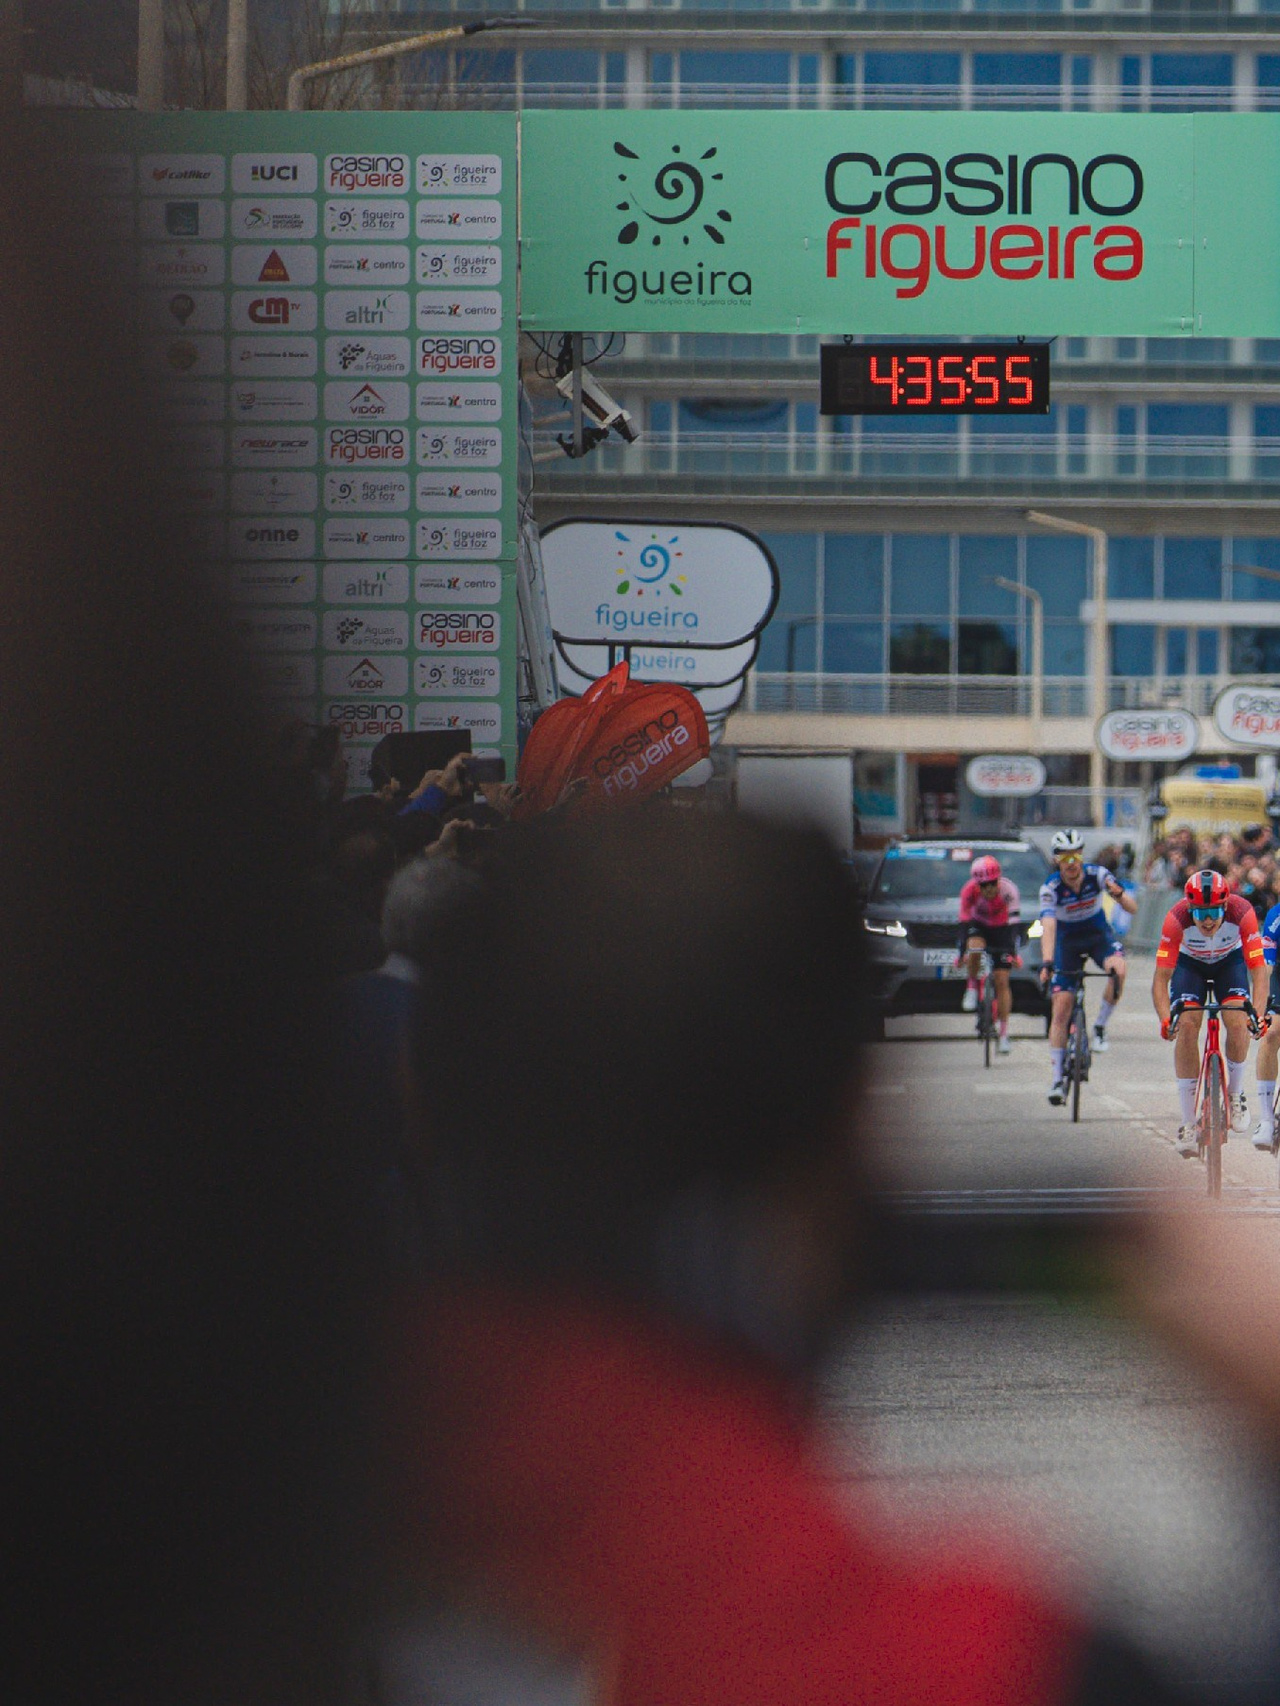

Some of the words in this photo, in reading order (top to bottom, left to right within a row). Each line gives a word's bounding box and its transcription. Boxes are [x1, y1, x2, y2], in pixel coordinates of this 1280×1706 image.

[330, 157, 403, 172] casino
[454, 165, 496, 175] figueira
[260, 166, 298, 181] UCI
[471, 175, 487, 183] foz
[330, 172, 404, 191] figueira
[825, 152, 1144, 216] casino
[363, 210, 404, 220] figueira
[465, 215, 496, 223] centro
[379, 220, 395, 228] foz
[454, 256, 496, 266] figueira
[826, 218, 1144, 298] figueira
[373, 260, 405, 269] centro
[471, 266, 487, 274] foz
[584, 261, 752, 303] figueira
[346, 306, 383, 324] altri
[465, 306, 496, 315] centro
[422, 339, 495, 354] casino
[366, 362, 405, 372] Figueira
[422, 354, 495, 373] figueira
[870, 356, 1033, 405] 4:35:55
[330, 429, 403, 444] casino
[454, 437, 496, 447] figueira
[330, 444, 404, 462] figueira
[471, 447, 487, 455] foz
[465, 487, 497, 496] centro
[246, 528, 299, 542] onne
[373, 533, 405, 542] centro
[454, 529, 496, 539] figueira
[471, 538, 487, 547] foz
[346, 579, 382, 596] altri
[464, 579, 496, 588] centro
[420, 614, 494, 628] casino
[596, 603, 698, 631] figueira
[420, 628, 494, 647] figueira
[616, 650, 696, 671] fgueira
[452, 667, 495, 677] figueira
[469, 676, 485, 685] foz
[329, 705, 403, 720] casino
[464, 719, 496, 727] centro
[604, 726, 689, 796] figueira
